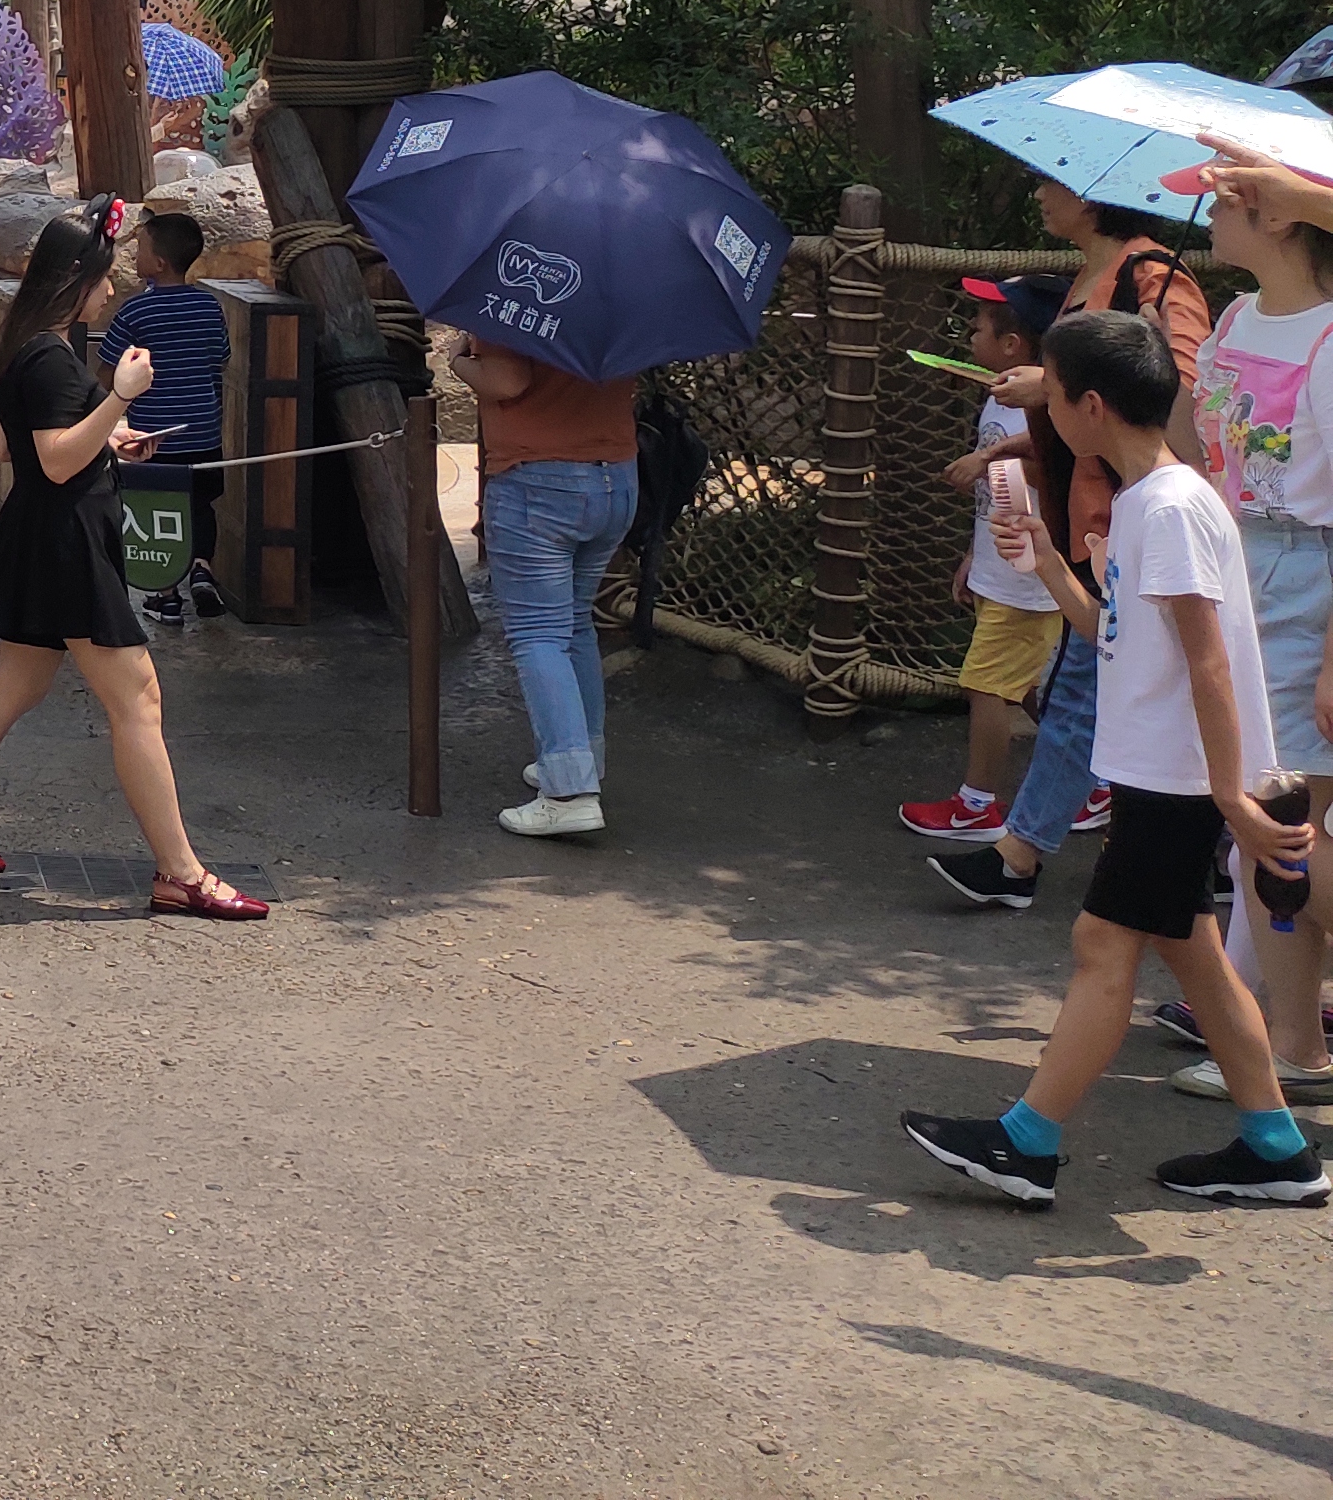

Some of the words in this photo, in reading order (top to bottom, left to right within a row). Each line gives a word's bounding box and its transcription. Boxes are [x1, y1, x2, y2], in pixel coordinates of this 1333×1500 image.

[509, 254, 540, 275] IVY
[122, 502, 184, 542] 入口
[124, 543, 173, 568] Entry
